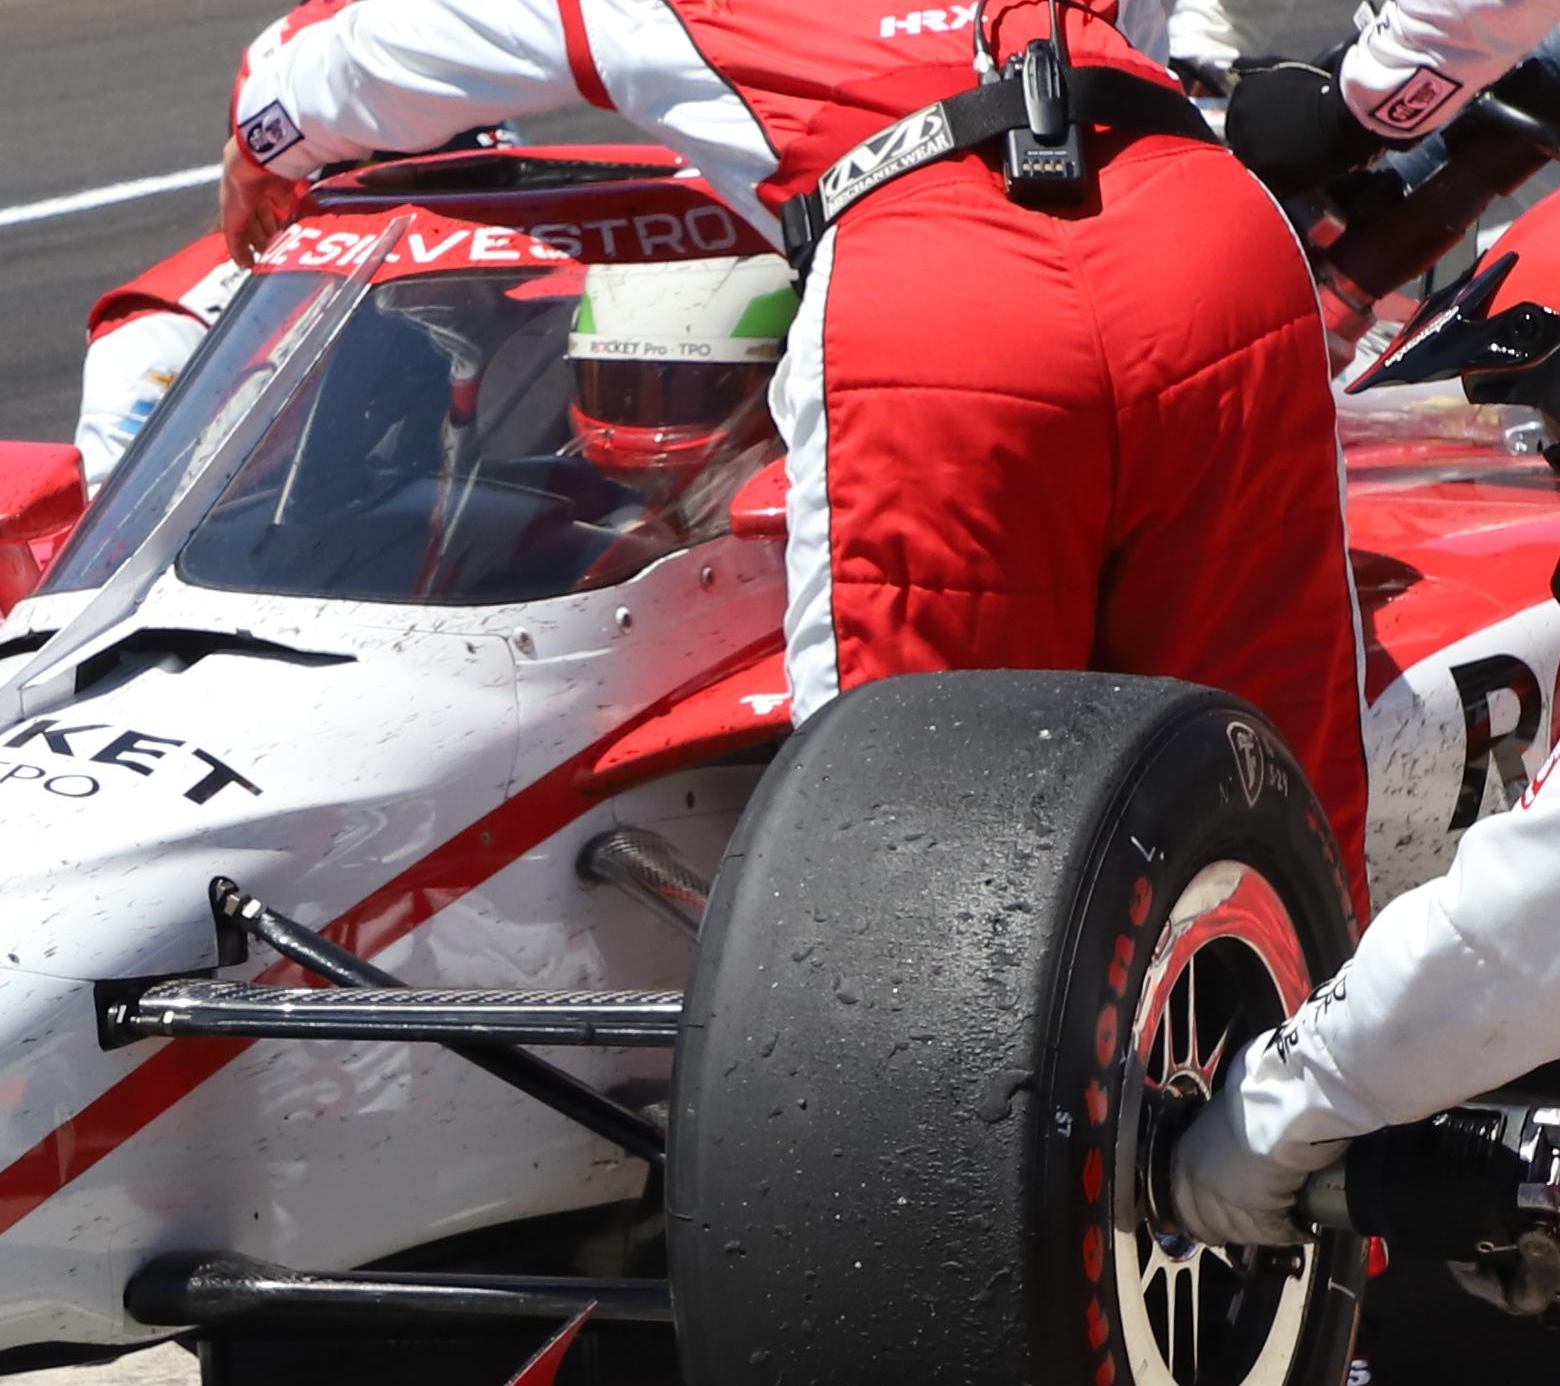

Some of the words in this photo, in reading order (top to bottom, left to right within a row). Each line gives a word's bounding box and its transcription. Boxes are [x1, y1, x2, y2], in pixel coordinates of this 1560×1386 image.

[881, 2, 988, 38] HRX
[898, 133, 949, 173] WEAR
[590, 340, 640, 356] ROCKET
[643, 341, 668, 357] Pro
[679, 342, 712, 357] TPO
